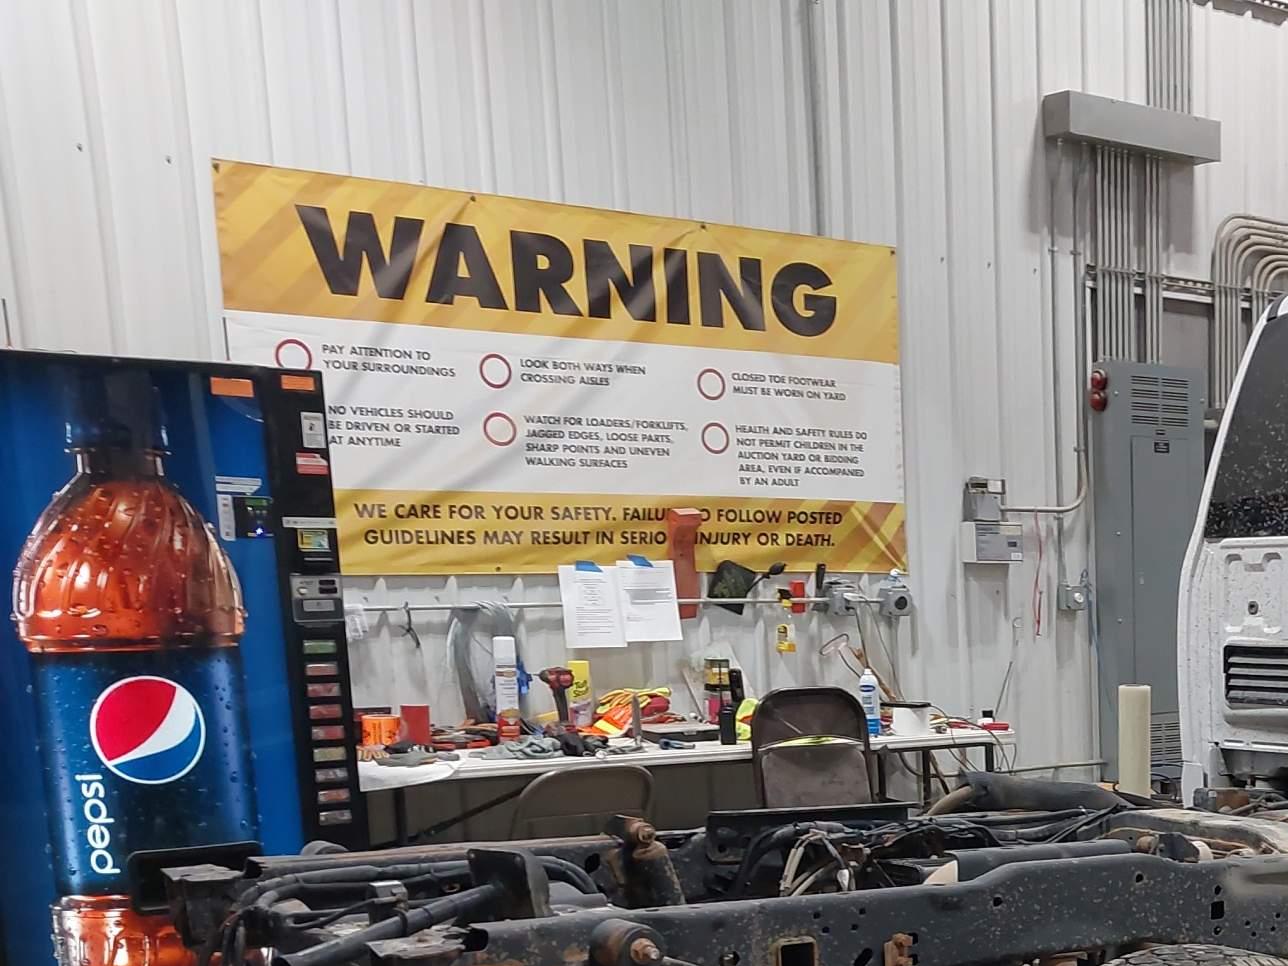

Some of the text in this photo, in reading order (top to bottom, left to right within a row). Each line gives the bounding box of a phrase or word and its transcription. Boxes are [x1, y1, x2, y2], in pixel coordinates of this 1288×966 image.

[296, 204, 837, 337] WARNING
[322, 344, 431, 361] PAY ATTENTION TO
[323, 359, 456, 377] YOUR SURROUNDINGS
[520, 358, 647, 375] LOOK BOTH WAYS WHEN
[520, 373, 610, 387] CROSSING AISLES
[731, 372, 837, 388] CLOSED TOE FOOTWEAR
[732, 385, 847, 401] MUST BE WORN ON YARD
[328, 405, 454, 421] NO VEHICLES SHOULD
[328, 420, 461, 436] BE DRIVEN OR STARTED
[524, 416, 689, 432] WATCH FOR LOADERS/FORKLIFTS,
[525, 430, 674, 445] JAGGED EDGES, LOOSE PARTS,
[735, 425, 868, 440] HEALTH AND SAFETY RULES DO
[329, 435, 401, 447] AT ANYTIME
[736, 438, 865, 452] NOT PERMIT CHILDREN IN THE
[525, 443, 671, 458] SHARP POINTS AND UNEVEN
[737, 451, 860, 464] AUCTION YARD OR BIDDING
[524, 456, 629, 470] WALKING SURFACES
[738, 464, 765, 474] AREA,
[767, 465, 792, 474] EVEN
[804, 467, 865, 477] ACCOMPANIED
[739, 477, 801, 487] BY AN ADULT
[353, 503, 388, 519] WE
[393, 504, 442, 520] CARE
[448, 504, 487, 520] FOR
[491, 505, 545, 521] YOUR
[550, 505, 618, 521] SAFETY.
[622, 507, 670, 521] FAILU
[716, 509, 783, 524] FOLLOW
[787, 510, 844, 526] POSTED
[364, 529, 836, 548] GUIDELINES MAY RESULT IN SERIO INJURY OR DEATH.
[74, 773, 121, 874] pepsi
